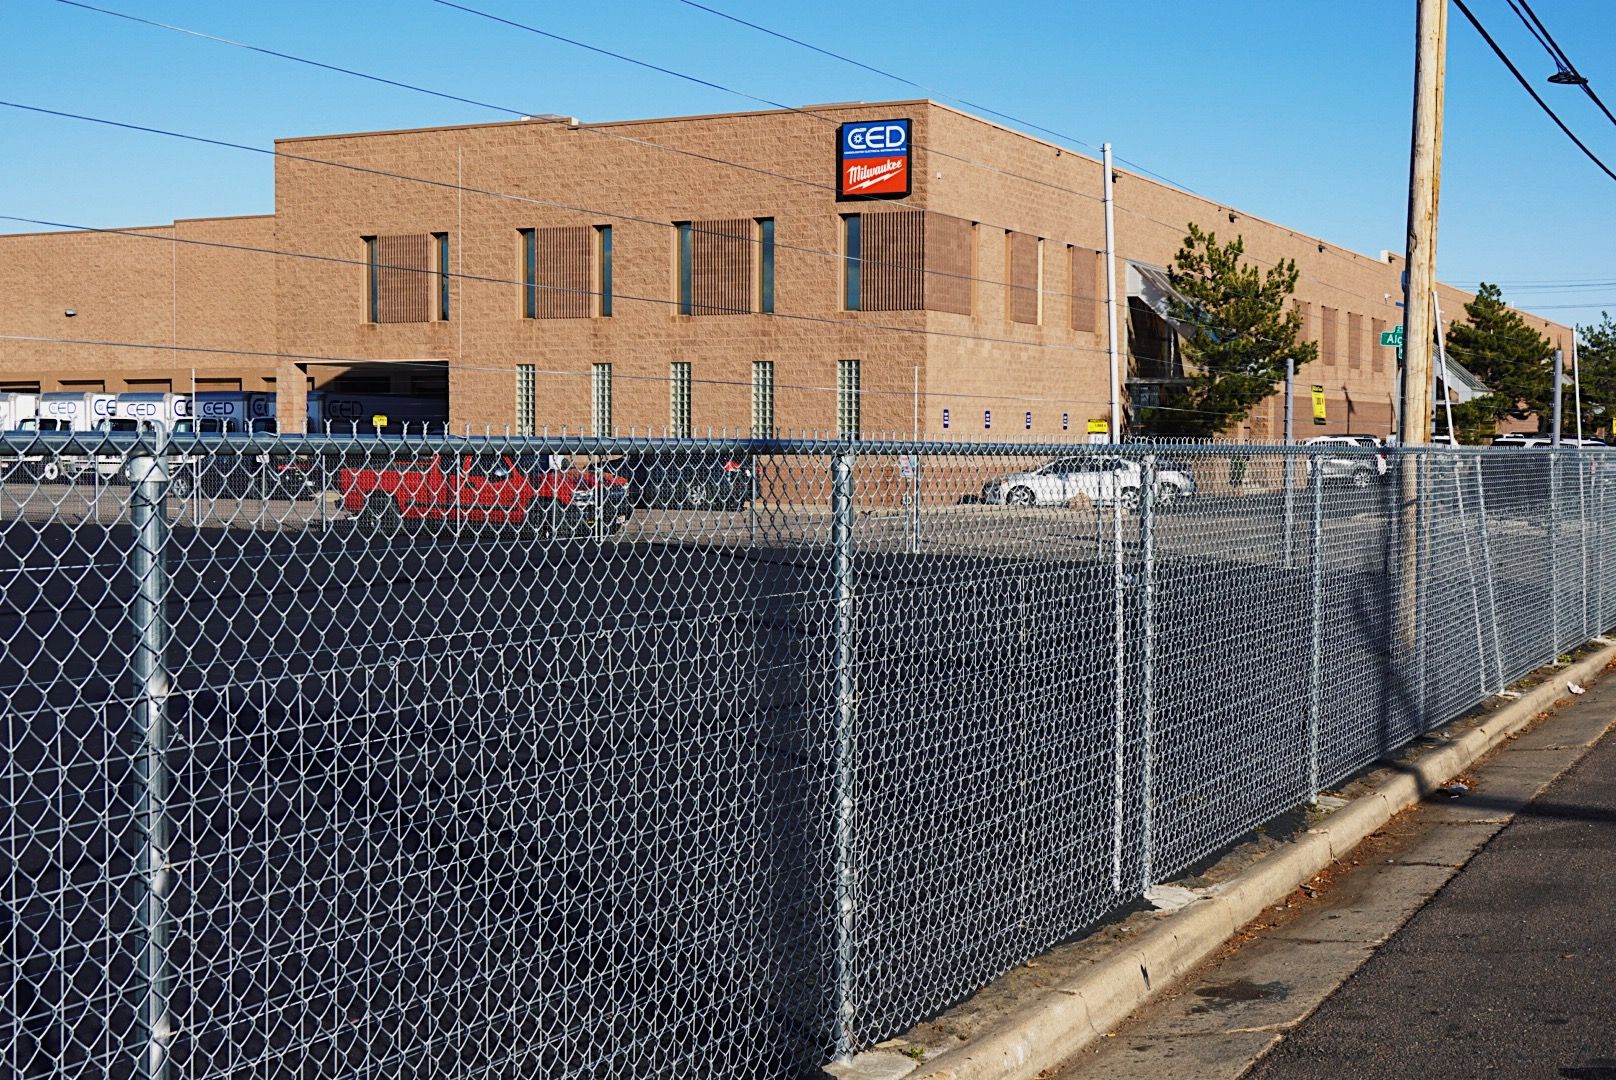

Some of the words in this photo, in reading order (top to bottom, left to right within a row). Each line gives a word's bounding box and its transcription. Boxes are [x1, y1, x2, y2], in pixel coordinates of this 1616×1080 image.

[848, 126, 905, 149] CED
[847, 160, 902, 184] Milwaukee
[1386, 334, 1402, 344] Alc
[49, 401, 77, 415] CED
[94, 398, 116, 416] CE
[127, 403, 157, 416] CED
[174, 399, 193, 417] CE
[203, 401, 234, 415] CED
